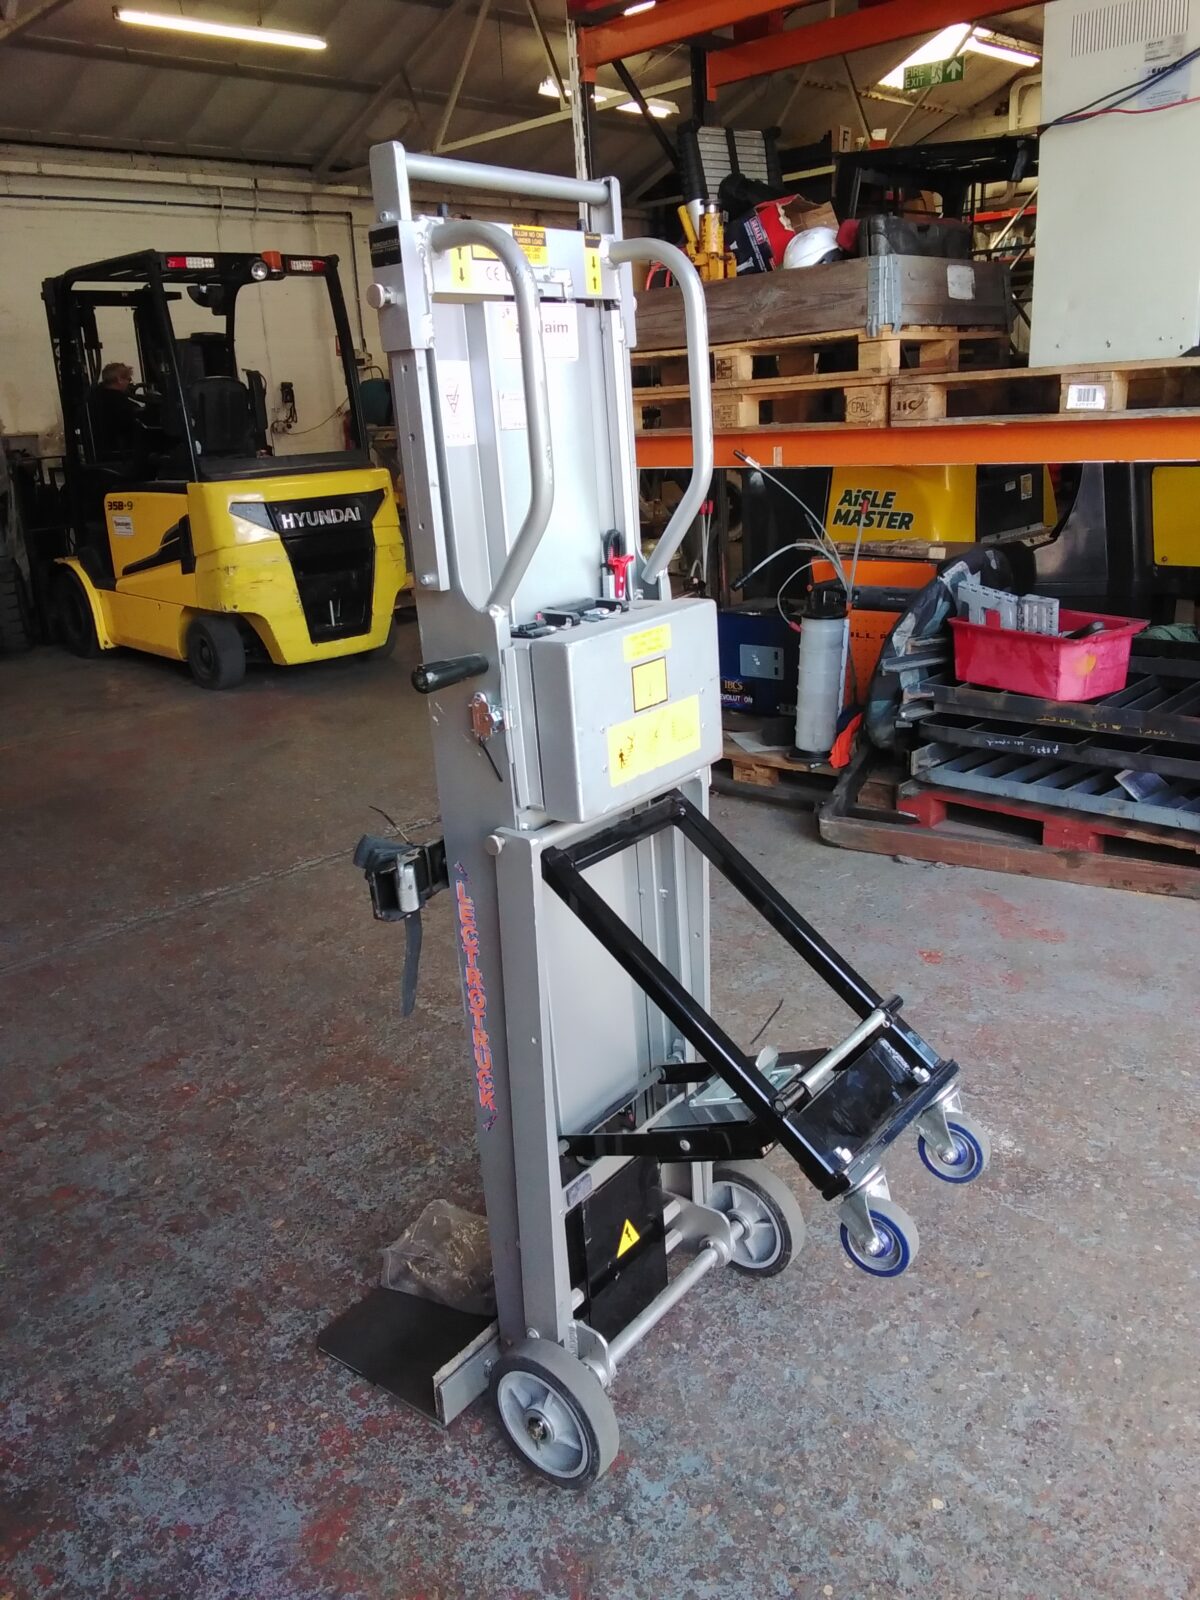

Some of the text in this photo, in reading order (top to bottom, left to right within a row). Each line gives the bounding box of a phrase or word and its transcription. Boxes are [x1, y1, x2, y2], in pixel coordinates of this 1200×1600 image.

[905, 66, 925, 79] FIRE
[905, 76, 924, 89] EXIT
[281, 506, 361, 529] HYUNDAI
[832, 508, 914, 531] MASTER
[456, 879, 498, 1112] LECTROTRUCK
